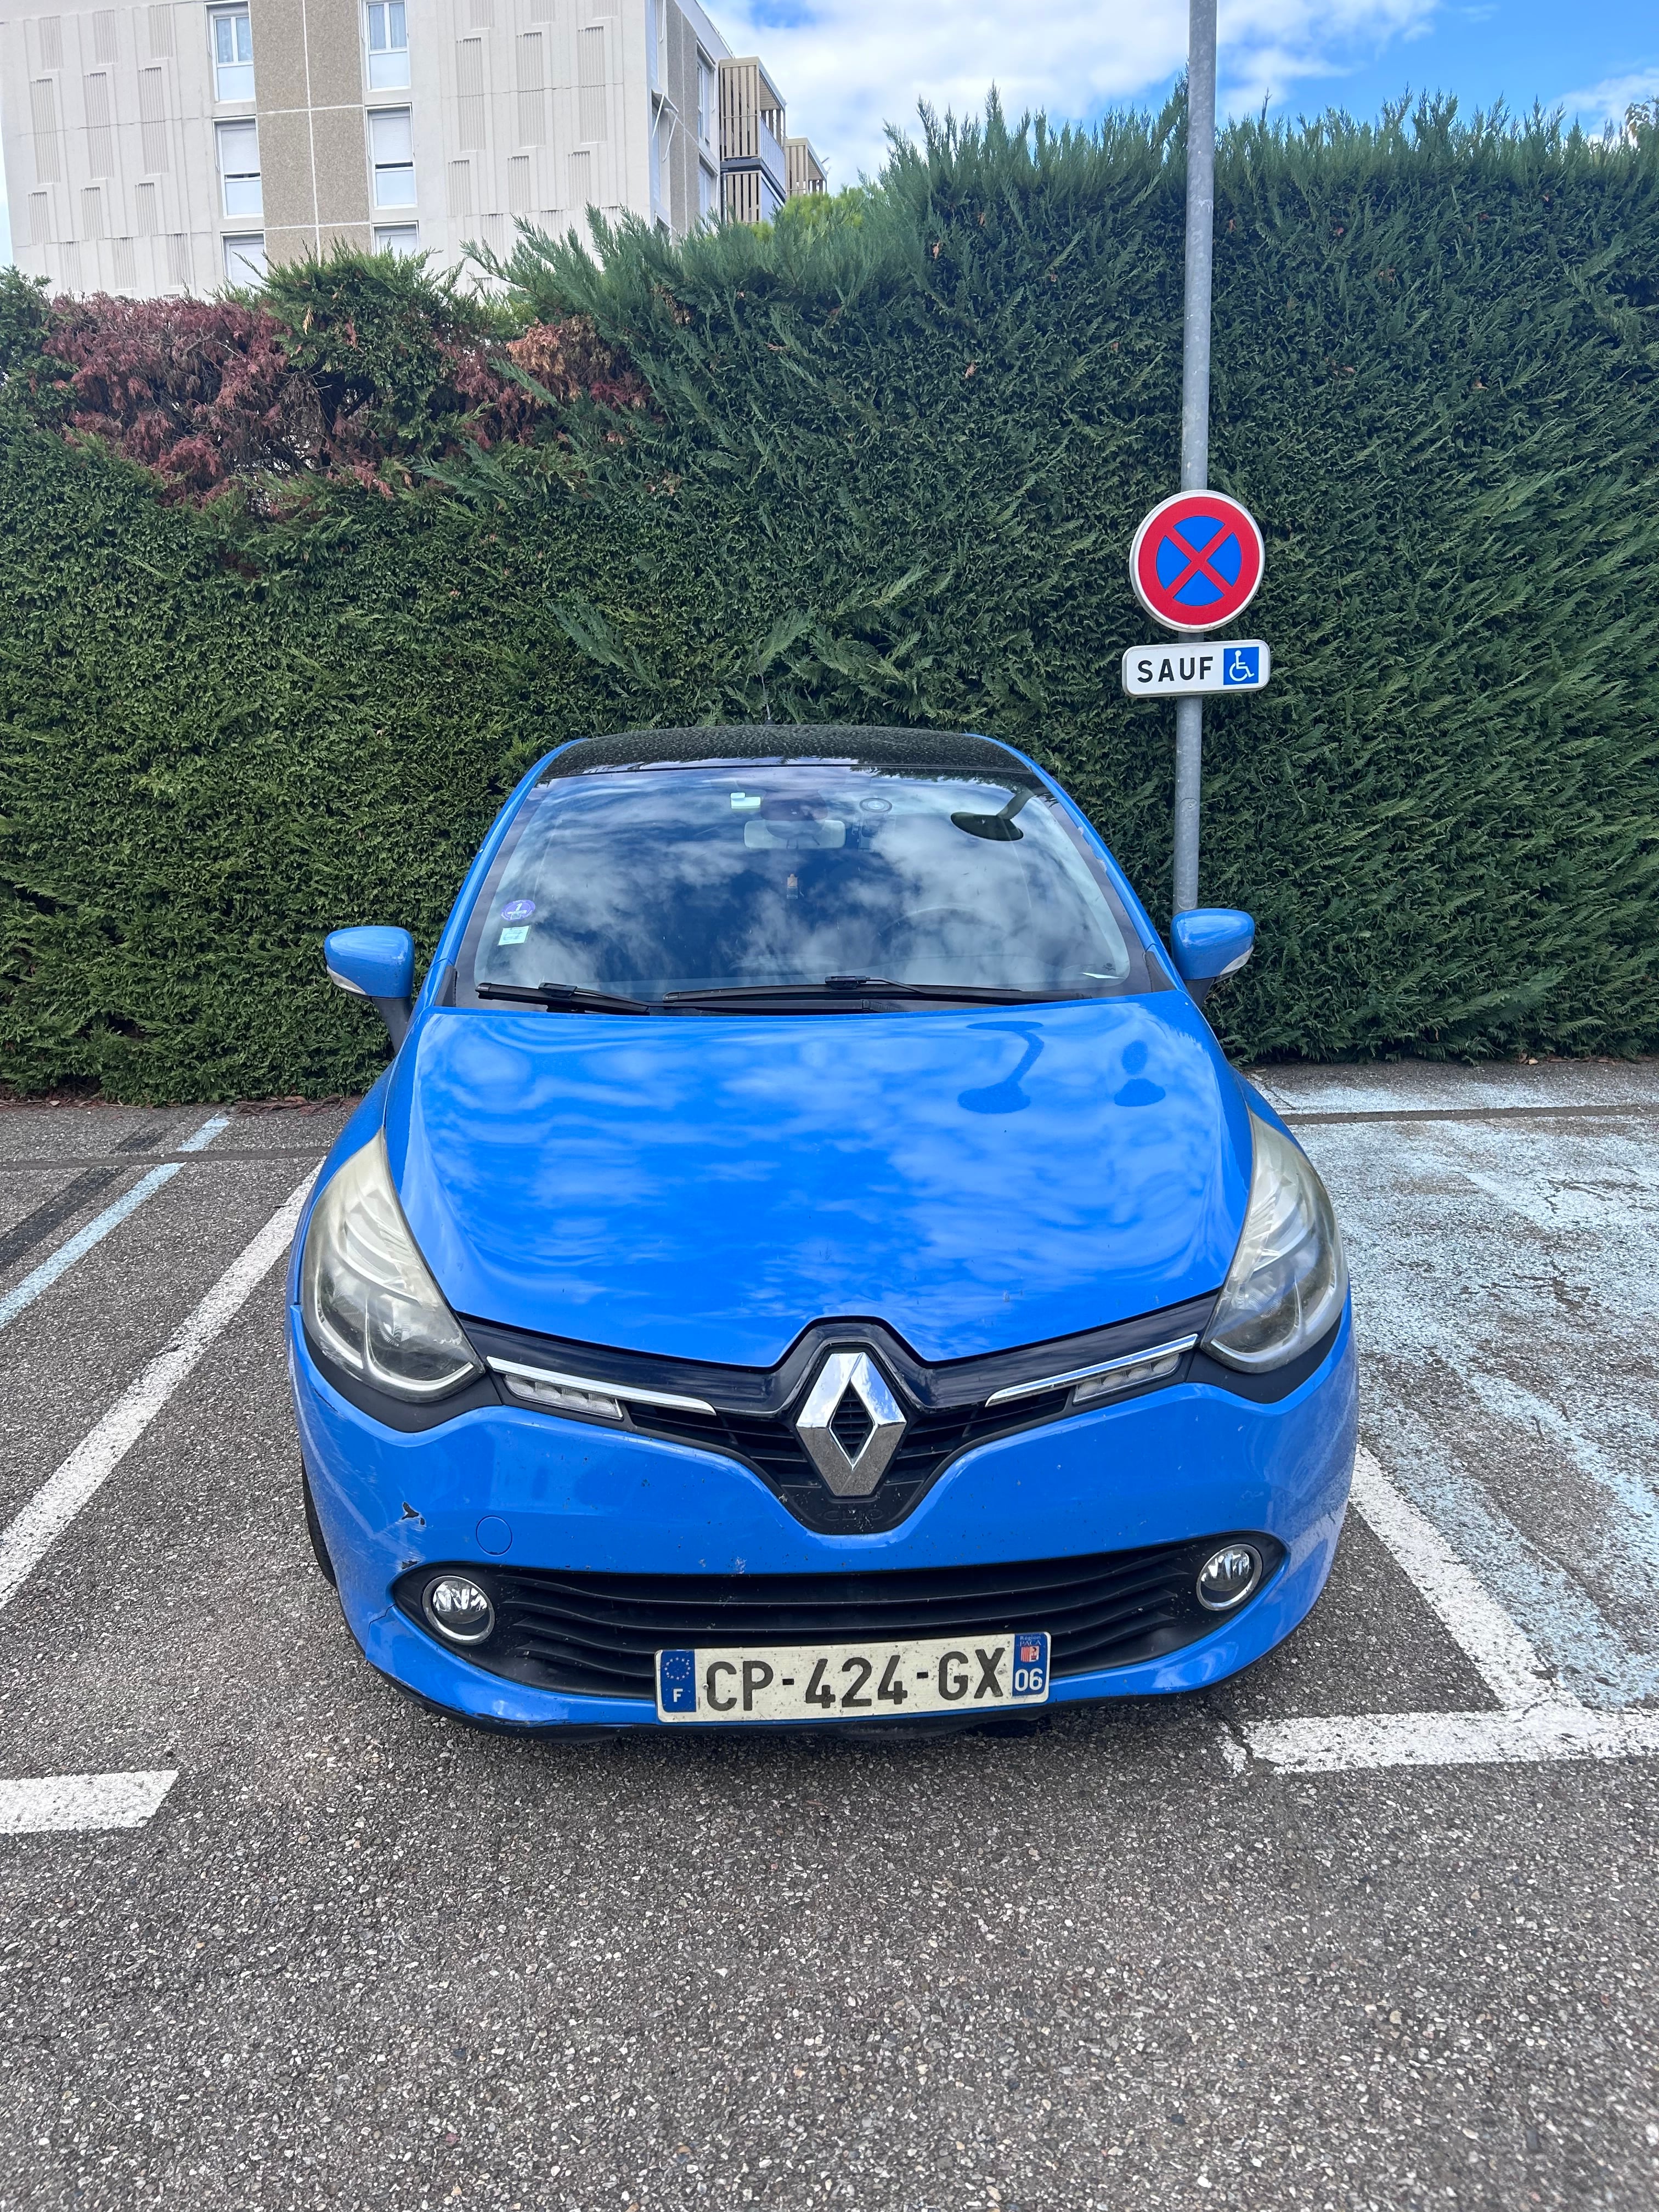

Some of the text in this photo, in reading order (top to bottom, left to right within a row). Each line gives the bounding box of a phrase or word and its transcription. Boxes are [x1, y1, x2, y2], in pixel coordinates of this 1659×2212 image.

[1137, 656, 1214, 683] SAUF
[824, 1509, 884, 1521] CLIO
[706, 1647, 1005, 1711] CP-424-GX
[1014, 1668, 1043, 1691] 06
[673, 1688, 684, 1703] F
